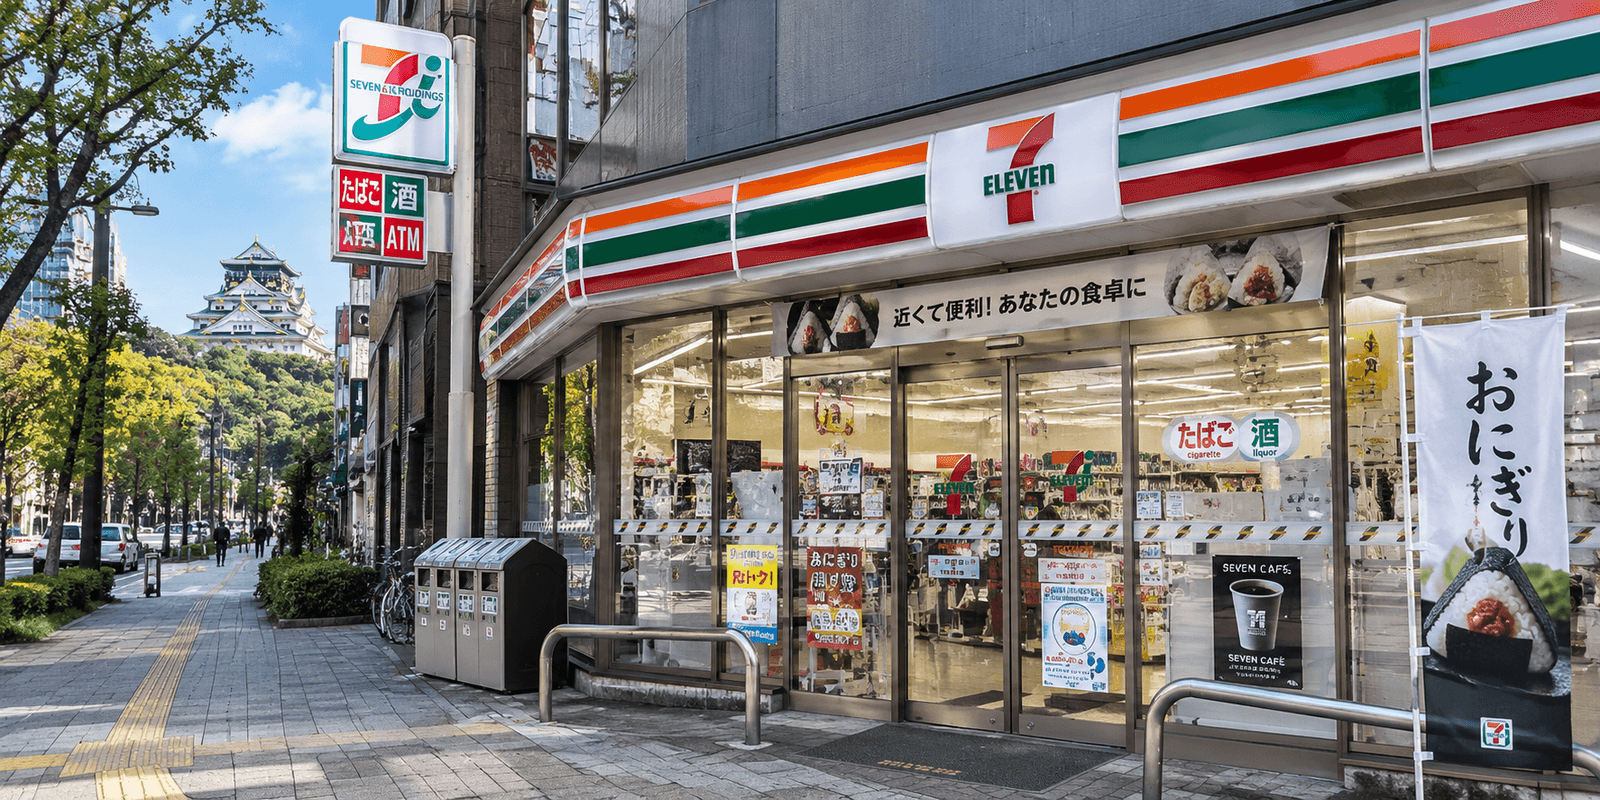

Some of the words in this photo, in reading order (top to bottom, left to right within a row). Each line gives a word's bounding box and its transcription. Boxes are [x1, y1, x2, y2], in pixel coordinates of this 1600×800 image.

[350, 79, 381, 92] SEVEN
[391, 181, 418, 211] 酒
[386, 225, 420, 252] ATM
[998, 277, 1147, 315] あなたの食卓に
[1251, 418, 1279, 448] 酒
[1466, 361, 1532, 557] おにぎり
[1222, 563, 1256, 573] SEVEN
[1228, 653, 1258, 664] SEVEN
